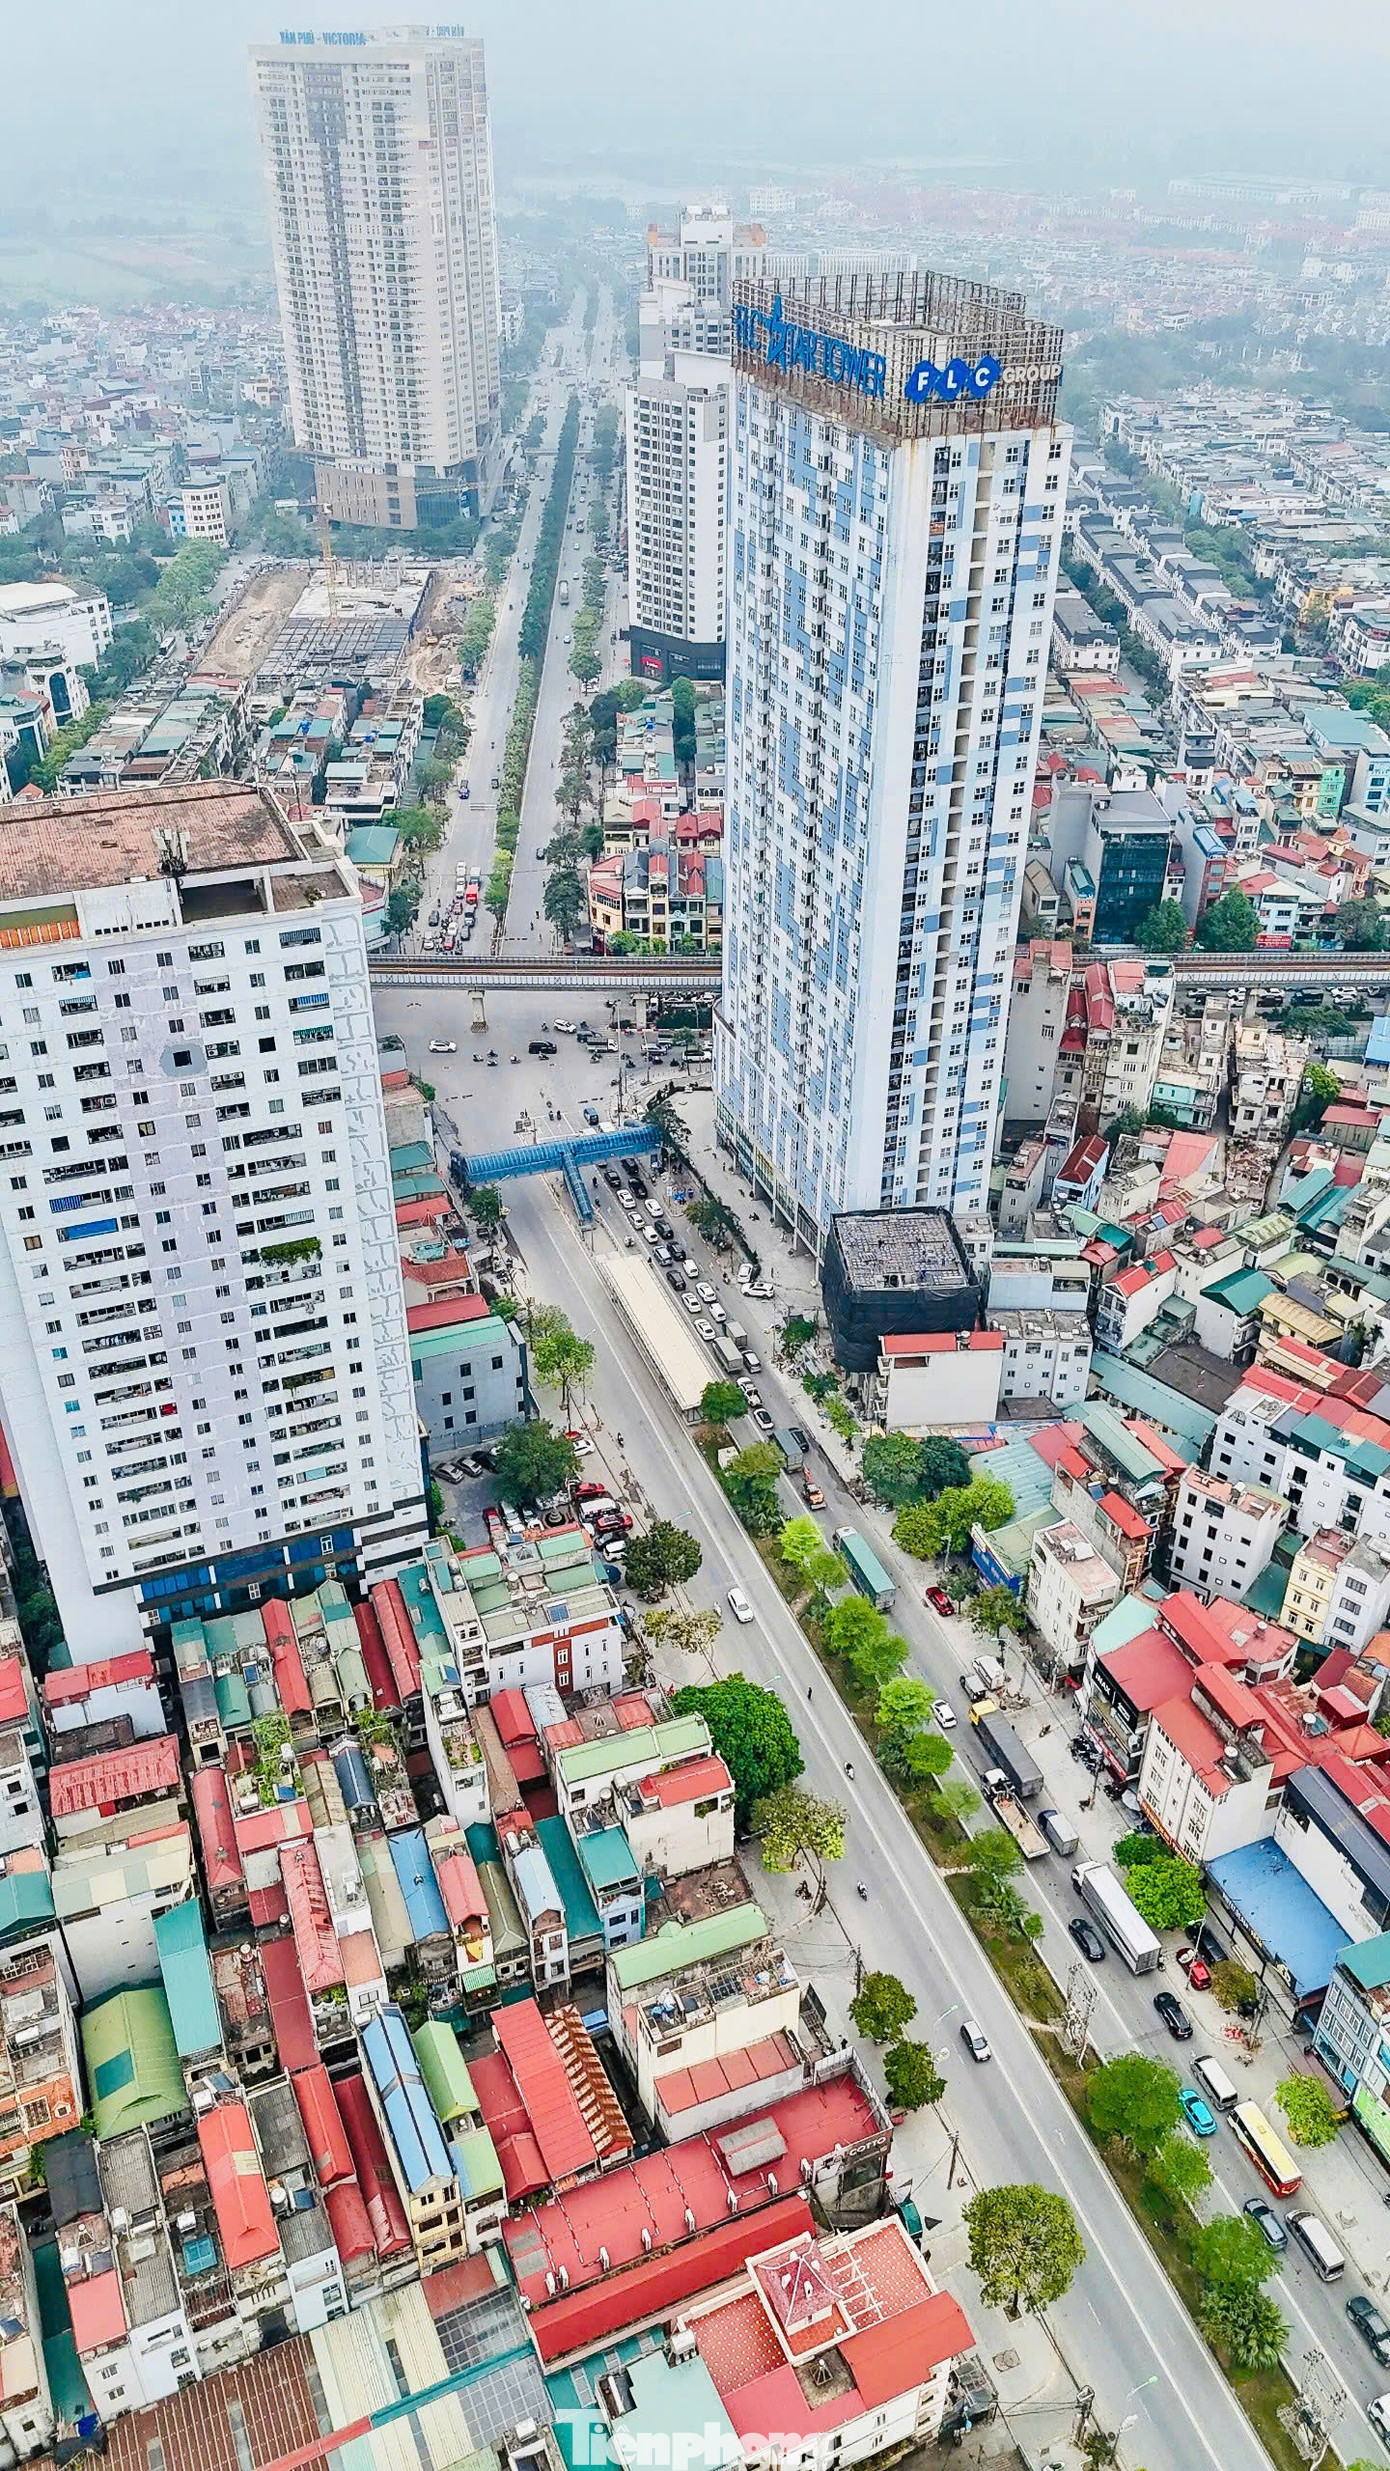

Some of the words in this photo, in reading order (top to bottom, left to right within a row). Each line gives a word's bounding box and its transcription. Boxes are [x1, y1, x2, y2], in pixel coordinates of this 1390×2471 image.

[322, 32, 366, 46] VICTORIA
[818, 334, 887, 399] TOWER
[1001, 364, 1062, 384] GROUP
[849, 2136, 886, 2157] COTTO
